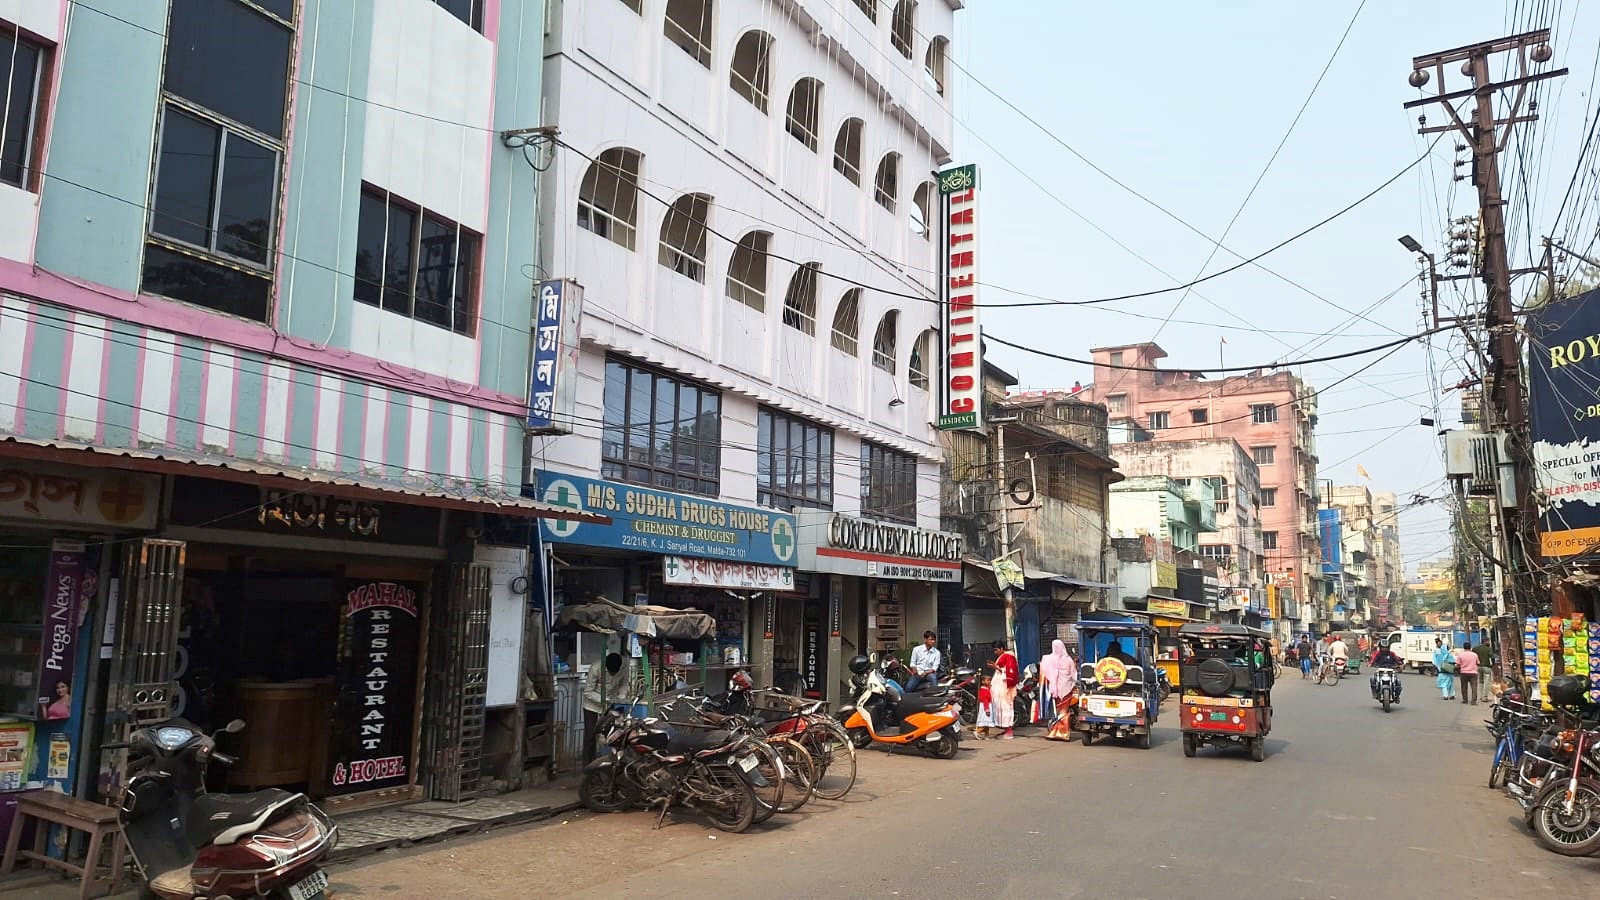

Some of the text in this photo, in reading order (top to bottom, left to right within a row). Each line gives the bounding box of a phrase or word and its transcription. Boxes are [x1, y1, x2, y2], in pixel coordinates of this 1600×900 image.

[950, 188, 975, 413] CONTINENTAL
[940, 415, 975, 425] RESIDENCY
[1542, 455, 1581, 470] SPECIAL
[1574, 471, 1587, 480] for
[587, 484, 769, 533] M/S. SUDHA DRUGS HOUSE
[635, 520, 736, 544] CHEMIST & DRUGGIST
[827, 515, 963, 561] CONTINENTAL LODGE
[1565, 539, 1575, 547] OF
[651, 540, 658, 548] K.
[660, 541, 666, 549] J.
[667, 541, 688, 554] Sanyal
[891, 567, 899, 576] ISO
[346, 583, 417, 615] MAHAL
[46, 575, 72, 671] Prega News
[808, 631, 816, 688] RESTAURANT
[362, 609, 391, 750] RESTAURANT
[332, 756, 406, 785] & HOTEL
